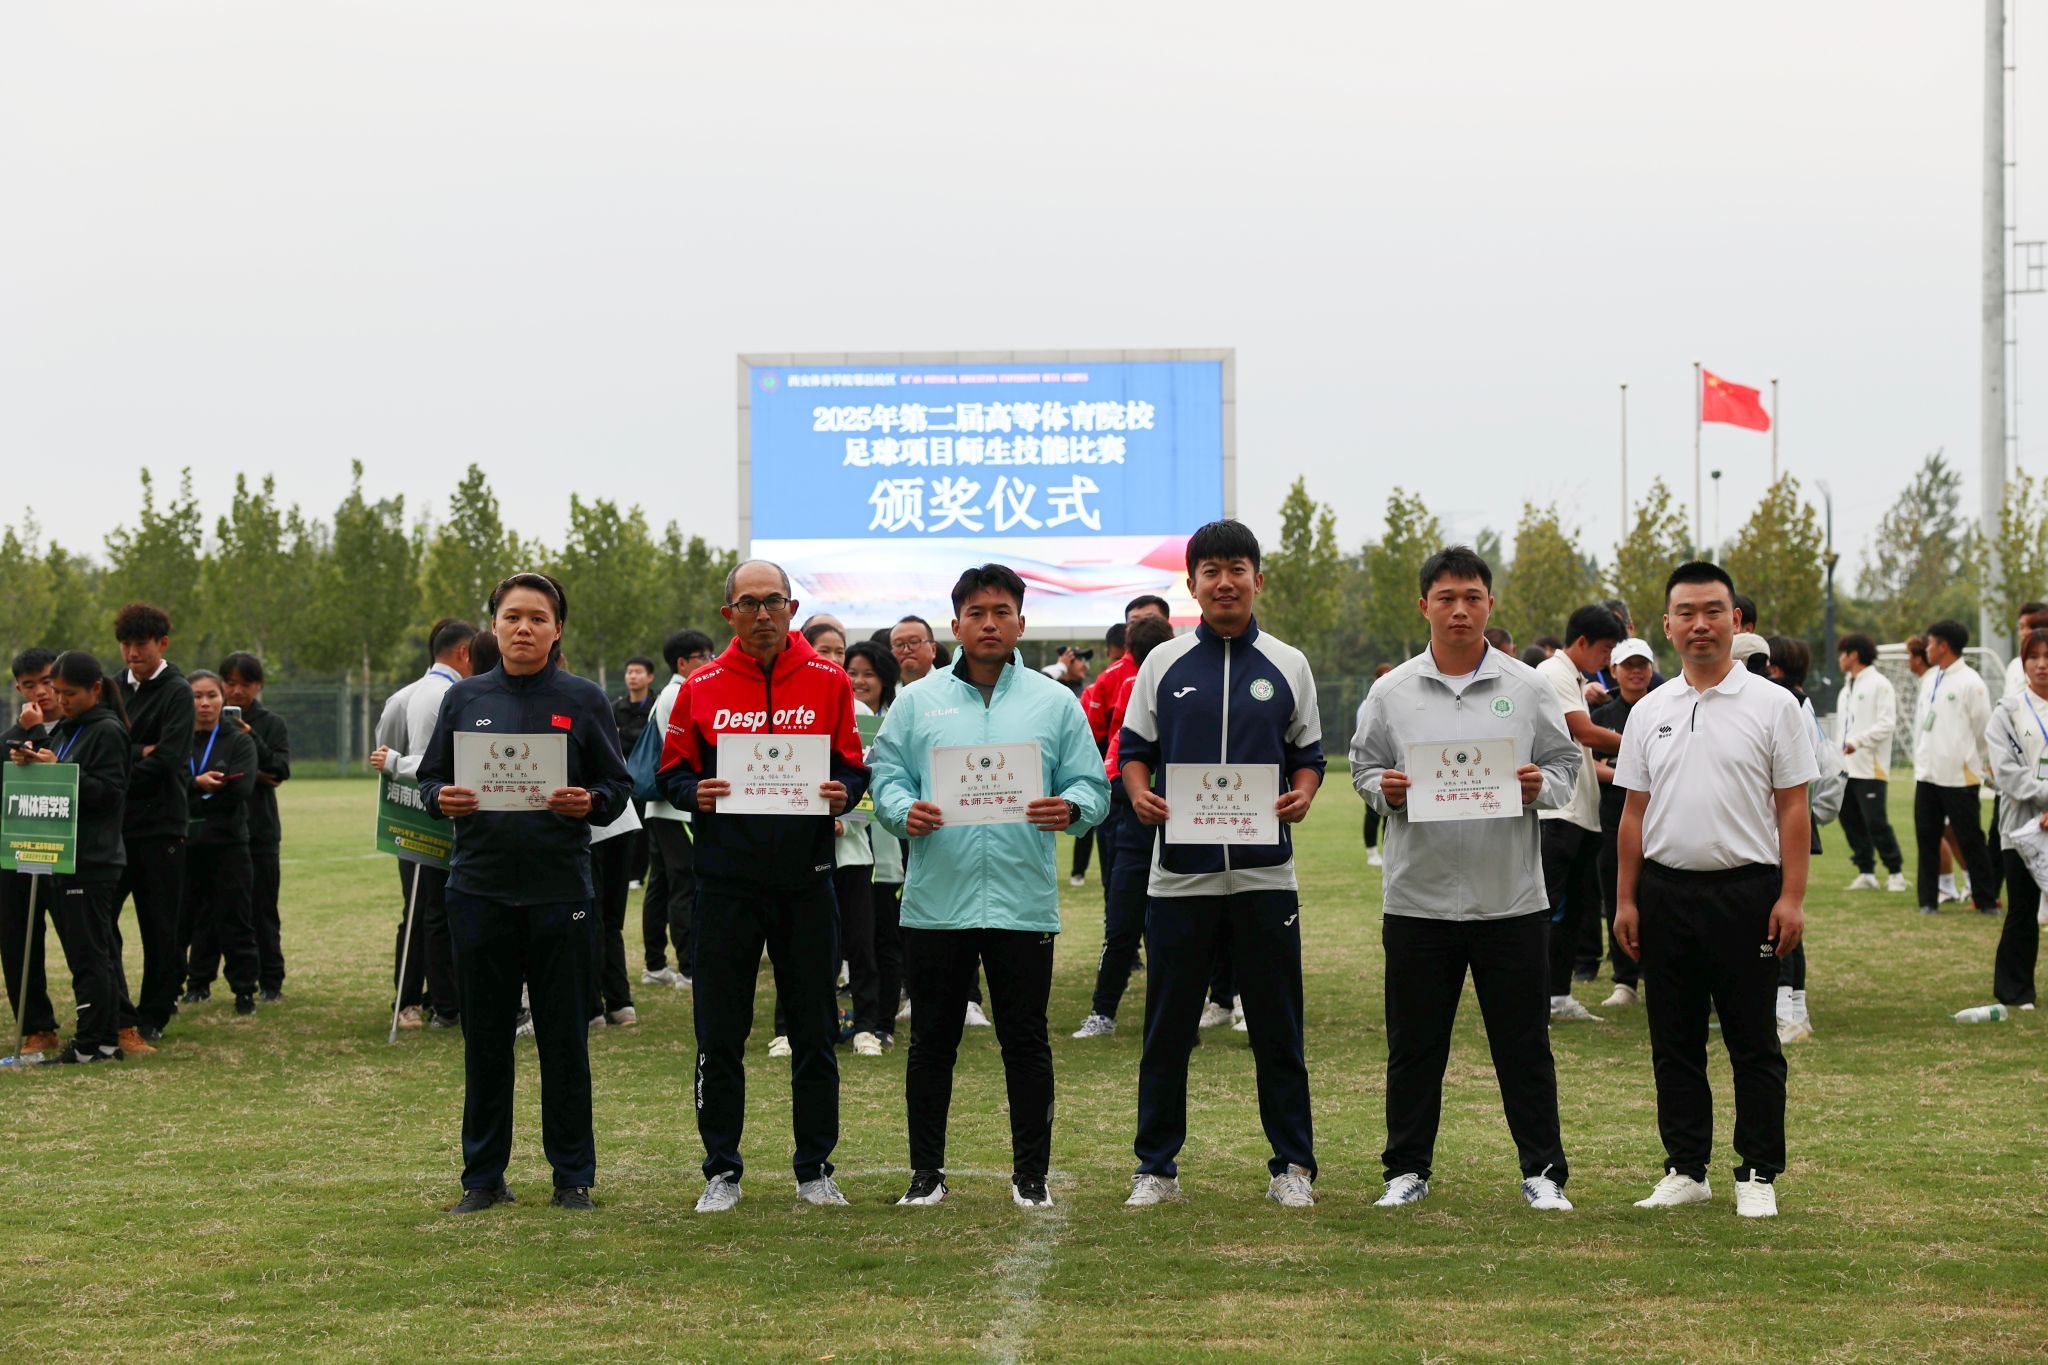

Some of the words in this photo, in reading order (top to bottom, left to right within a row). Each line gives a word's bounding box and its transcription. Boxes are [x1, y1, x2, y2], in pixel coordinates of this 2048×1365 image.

[812, 400, 1156, 434] 2025年第二届高等体育院校
[842, 434, 1127, 467] 足球项目师生技能比赛
[867, 474, 1102, 533] 颁奖仪式
[712, 704, 816, 733] Desporte
[386, 781, 427, 811] 海南师
[744, 787, 804, 796] 教师三等奖
[959, 795, 1018, 807] 教师三等奖
[1434, 791, 1495, 803] 教师三等奖
[8, 794, 70, 819] 广州体育学院
[1193, 817, 1252, 826] 教师三等奖
